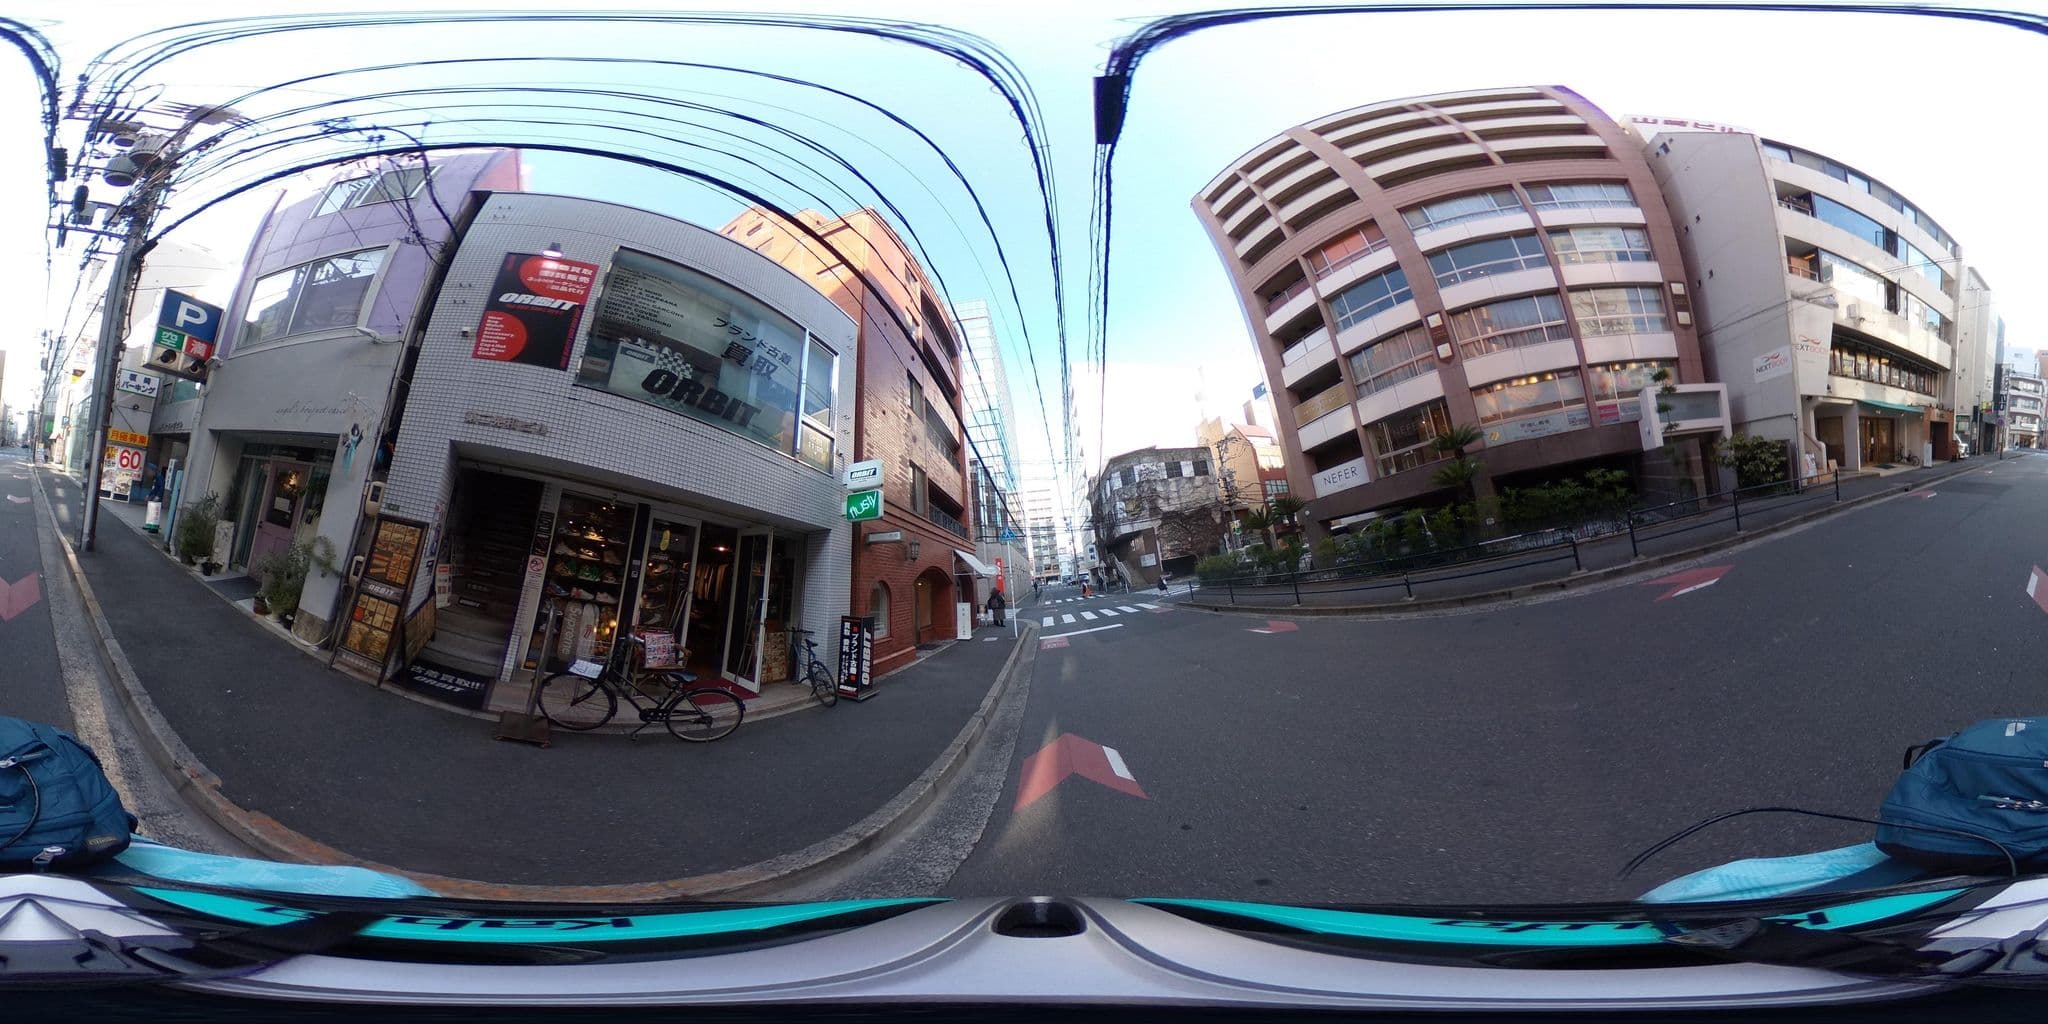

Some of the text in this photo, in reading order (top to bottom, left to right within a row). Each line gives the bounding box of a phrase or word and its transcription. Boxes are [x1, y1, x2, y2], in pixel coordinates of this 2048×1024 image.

[498, 292, 580, 311] ORBIT
[175, 301, 208, 328] P
[160, 331, 178, 348] 空
[190, 339, 207, 357] 満
[712, 314, 793, 366] ブランド古着
[721, 341, 778, 381] 買取
[120, 381, 156, 395] パーキング
[641, 368, 762, 428] ORBIT
[119, 449, 142, 470] 60
[1323, 466, 1358, 486] NEFER
[368, 584, 394, 597] ORBIT
[559, 606, 583, 656] Supreme
[861, 627, 872, 686] ORBIT
[413, 675, 465, 693] ORBIT
